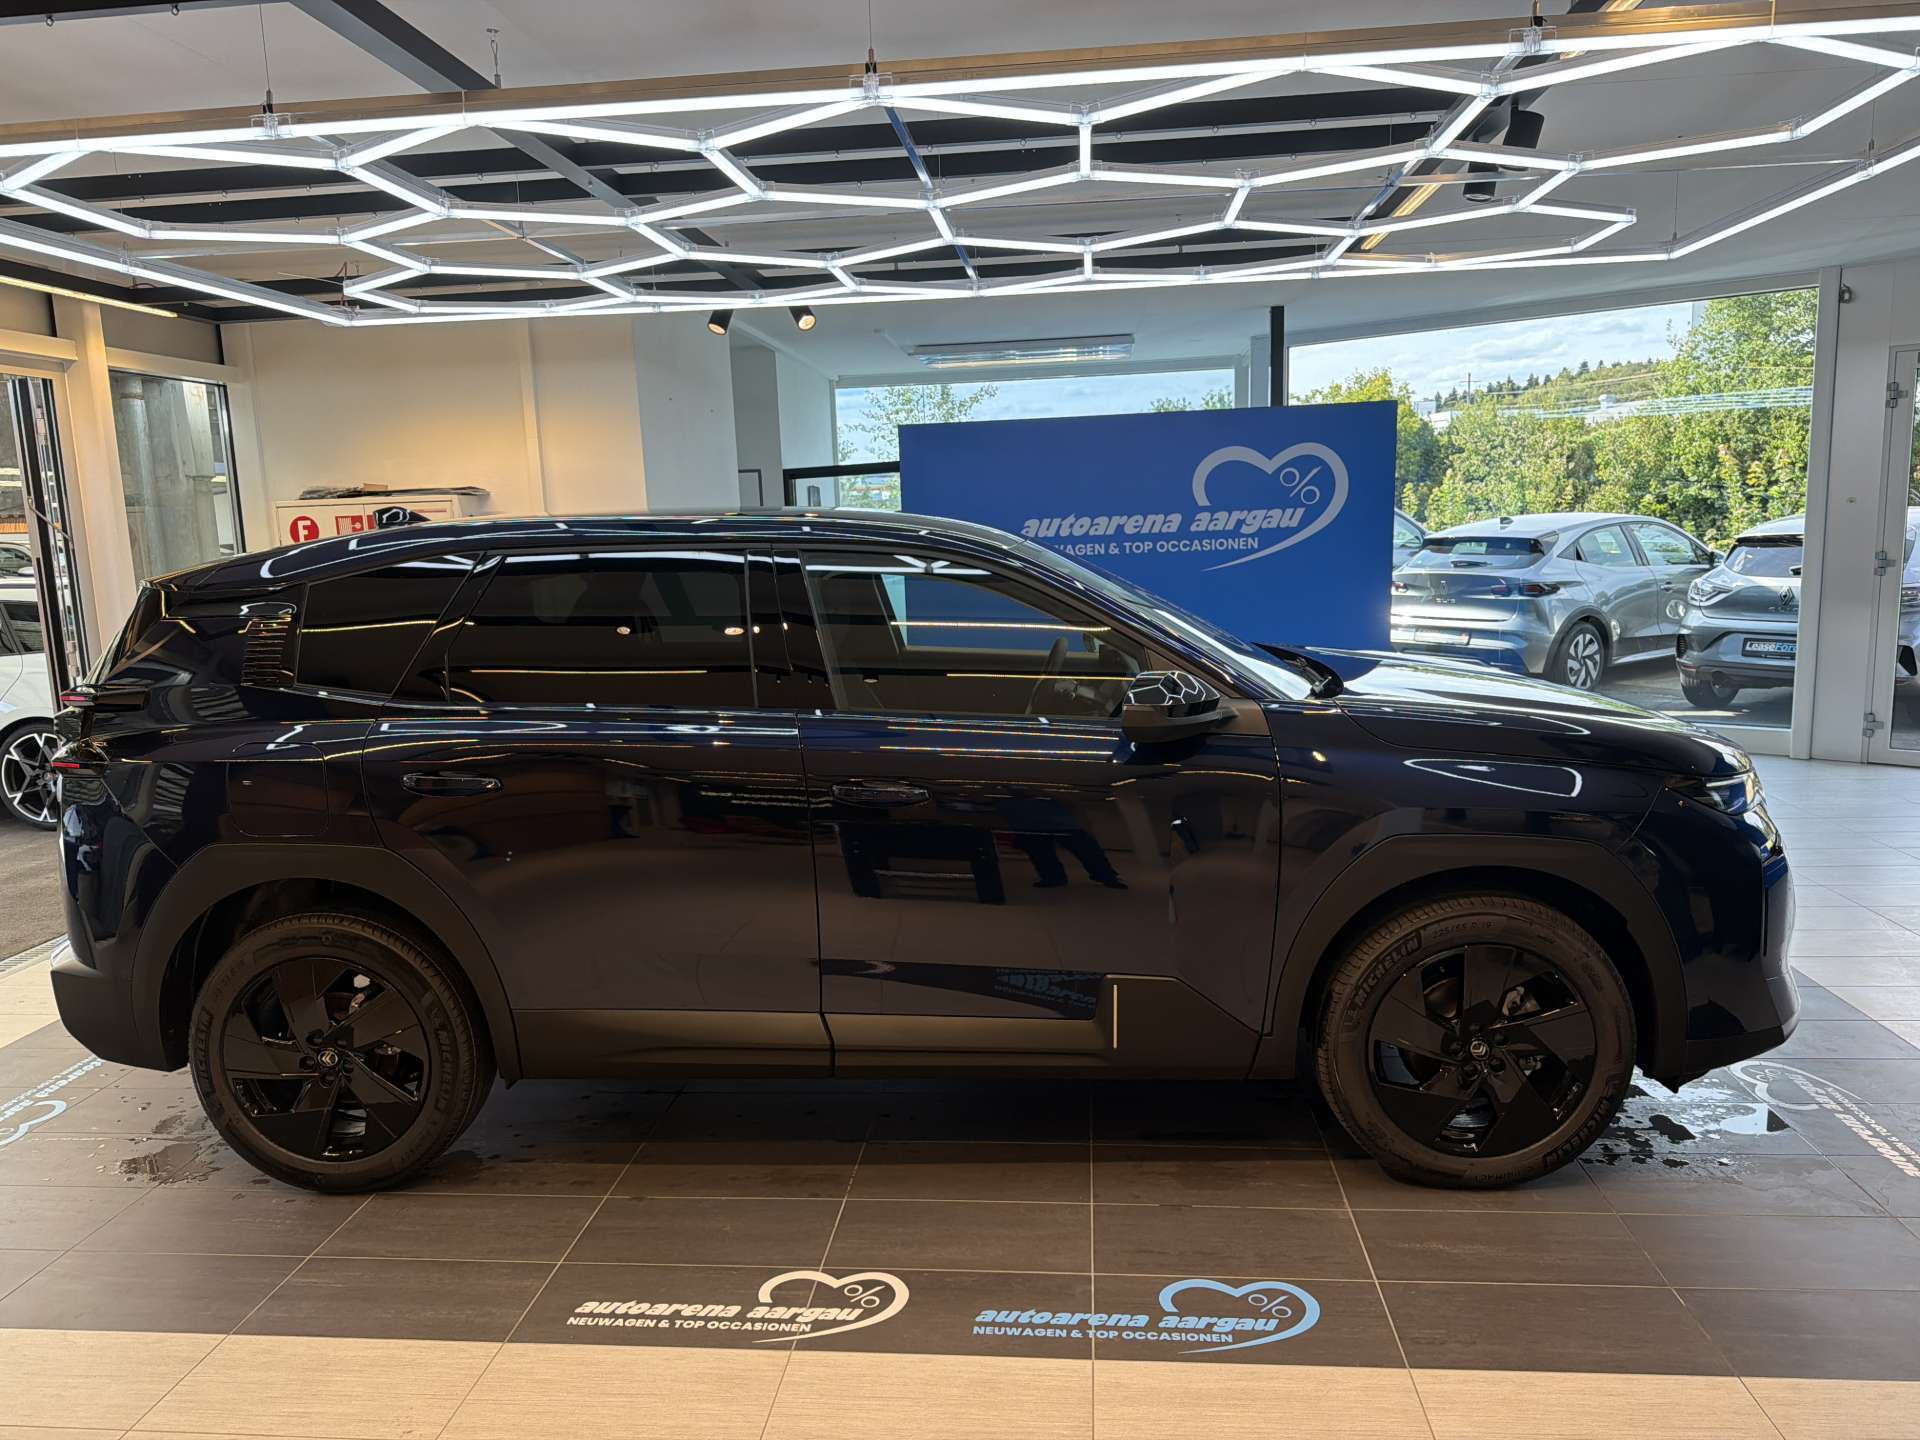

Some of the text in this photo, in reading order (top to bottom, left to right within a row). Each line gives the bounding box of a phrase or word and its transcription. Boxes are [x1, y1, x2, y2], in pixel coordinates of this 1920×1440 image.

[1020, 507, 1305, 538] autoarena aargau
[1109, 543, 1121, 555] &
[1123, 541, 1153, 554] TOP
[1156, 537, 1259, 552] OCCASIONEN
[574, 1299, 864, 1323] autoarena aargau
[975, 1308, 1280, 1333] autoarena aargau
[566, 1316, 812, 1332] NEUWAGEN & TOP OCCASIONEN
[972, 1325, 1233, 1343] NEUWAGEN & TOP OCCASIONEN
